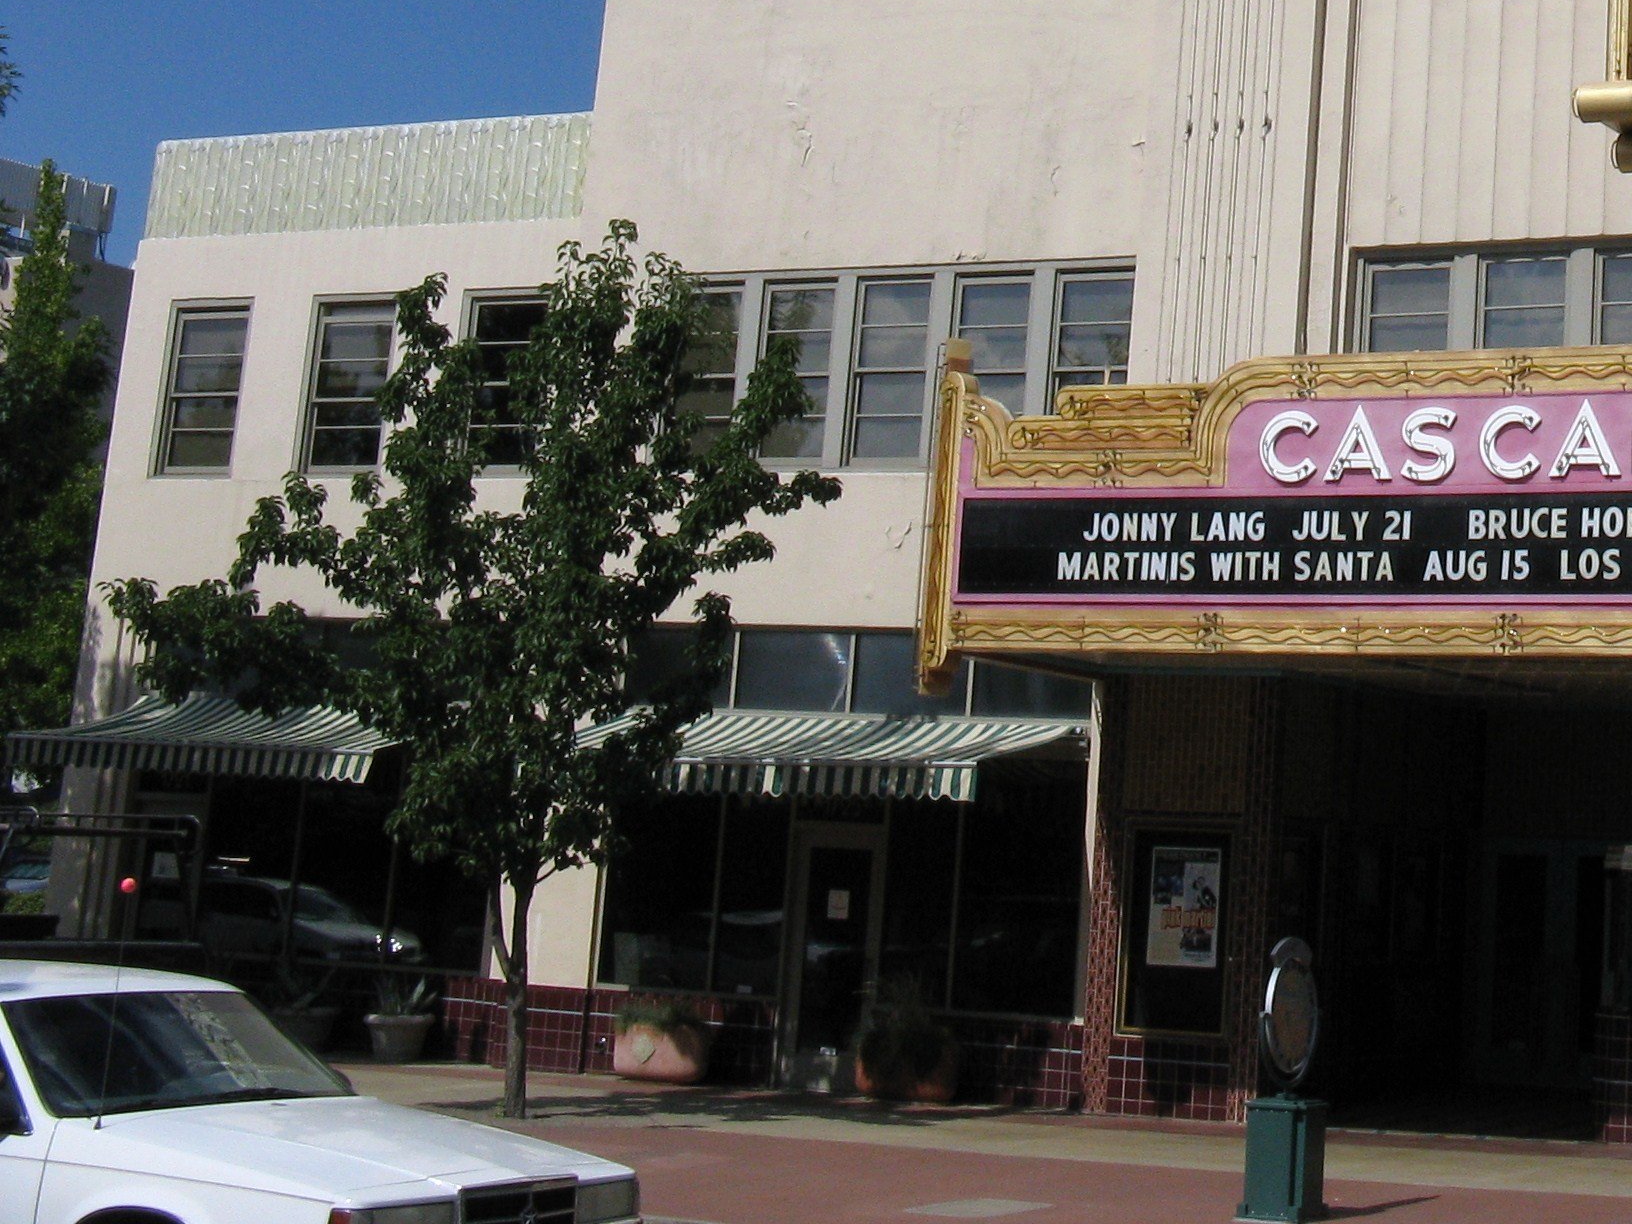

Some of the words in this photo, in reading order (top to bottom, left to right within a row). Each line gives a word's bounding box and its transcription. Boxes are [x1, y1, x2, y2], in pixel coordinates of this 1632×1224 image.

[1083, 511, 1175, 542] JONNY
[1190, 511, 1265, 542] LANG
[1291, 509, 1370, 542] JULY
[1382, 509, 1411, 541] 21
[1468, 507, 1567, 540] BRUCE
[1057, 551, 1195, 582] MARTINIS
[1210, 552, 1280, 581] WITH
[1294, 551, 1394, 581] SANTA
[1423, 550, 1488, 581] AUG
[1501, 549, 1531, 579] 15
[1560, 548, 1621, 580] LOS
